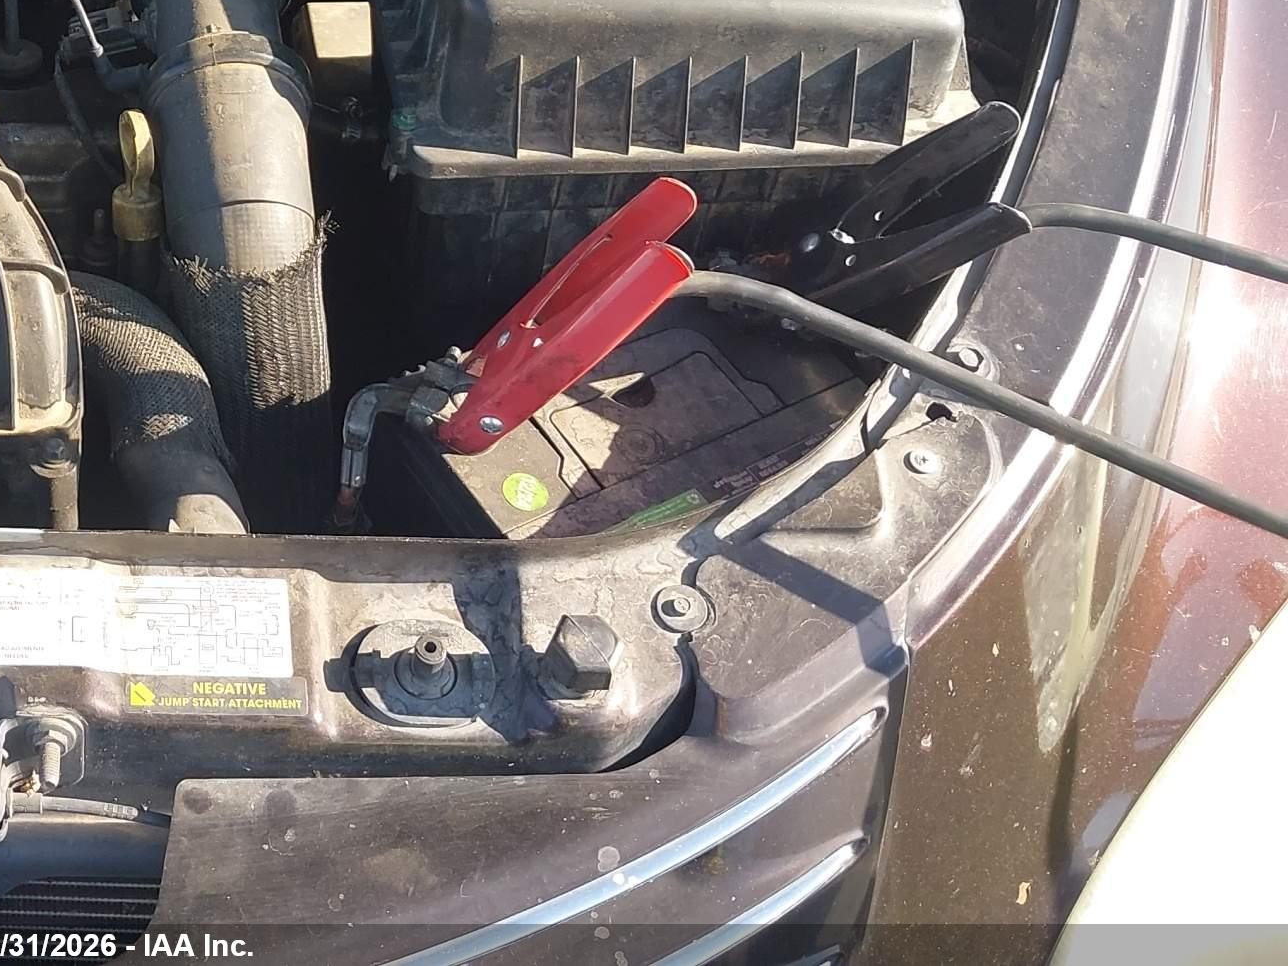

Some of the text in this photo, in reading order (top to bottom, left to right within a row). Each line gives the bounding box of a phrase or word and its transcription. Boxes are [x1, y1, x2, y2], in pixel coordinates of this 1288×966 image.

[193, 682, 266, 696] NEGATIVE
[158, 697, 303, 709] JUMP START ATTACHMENT
